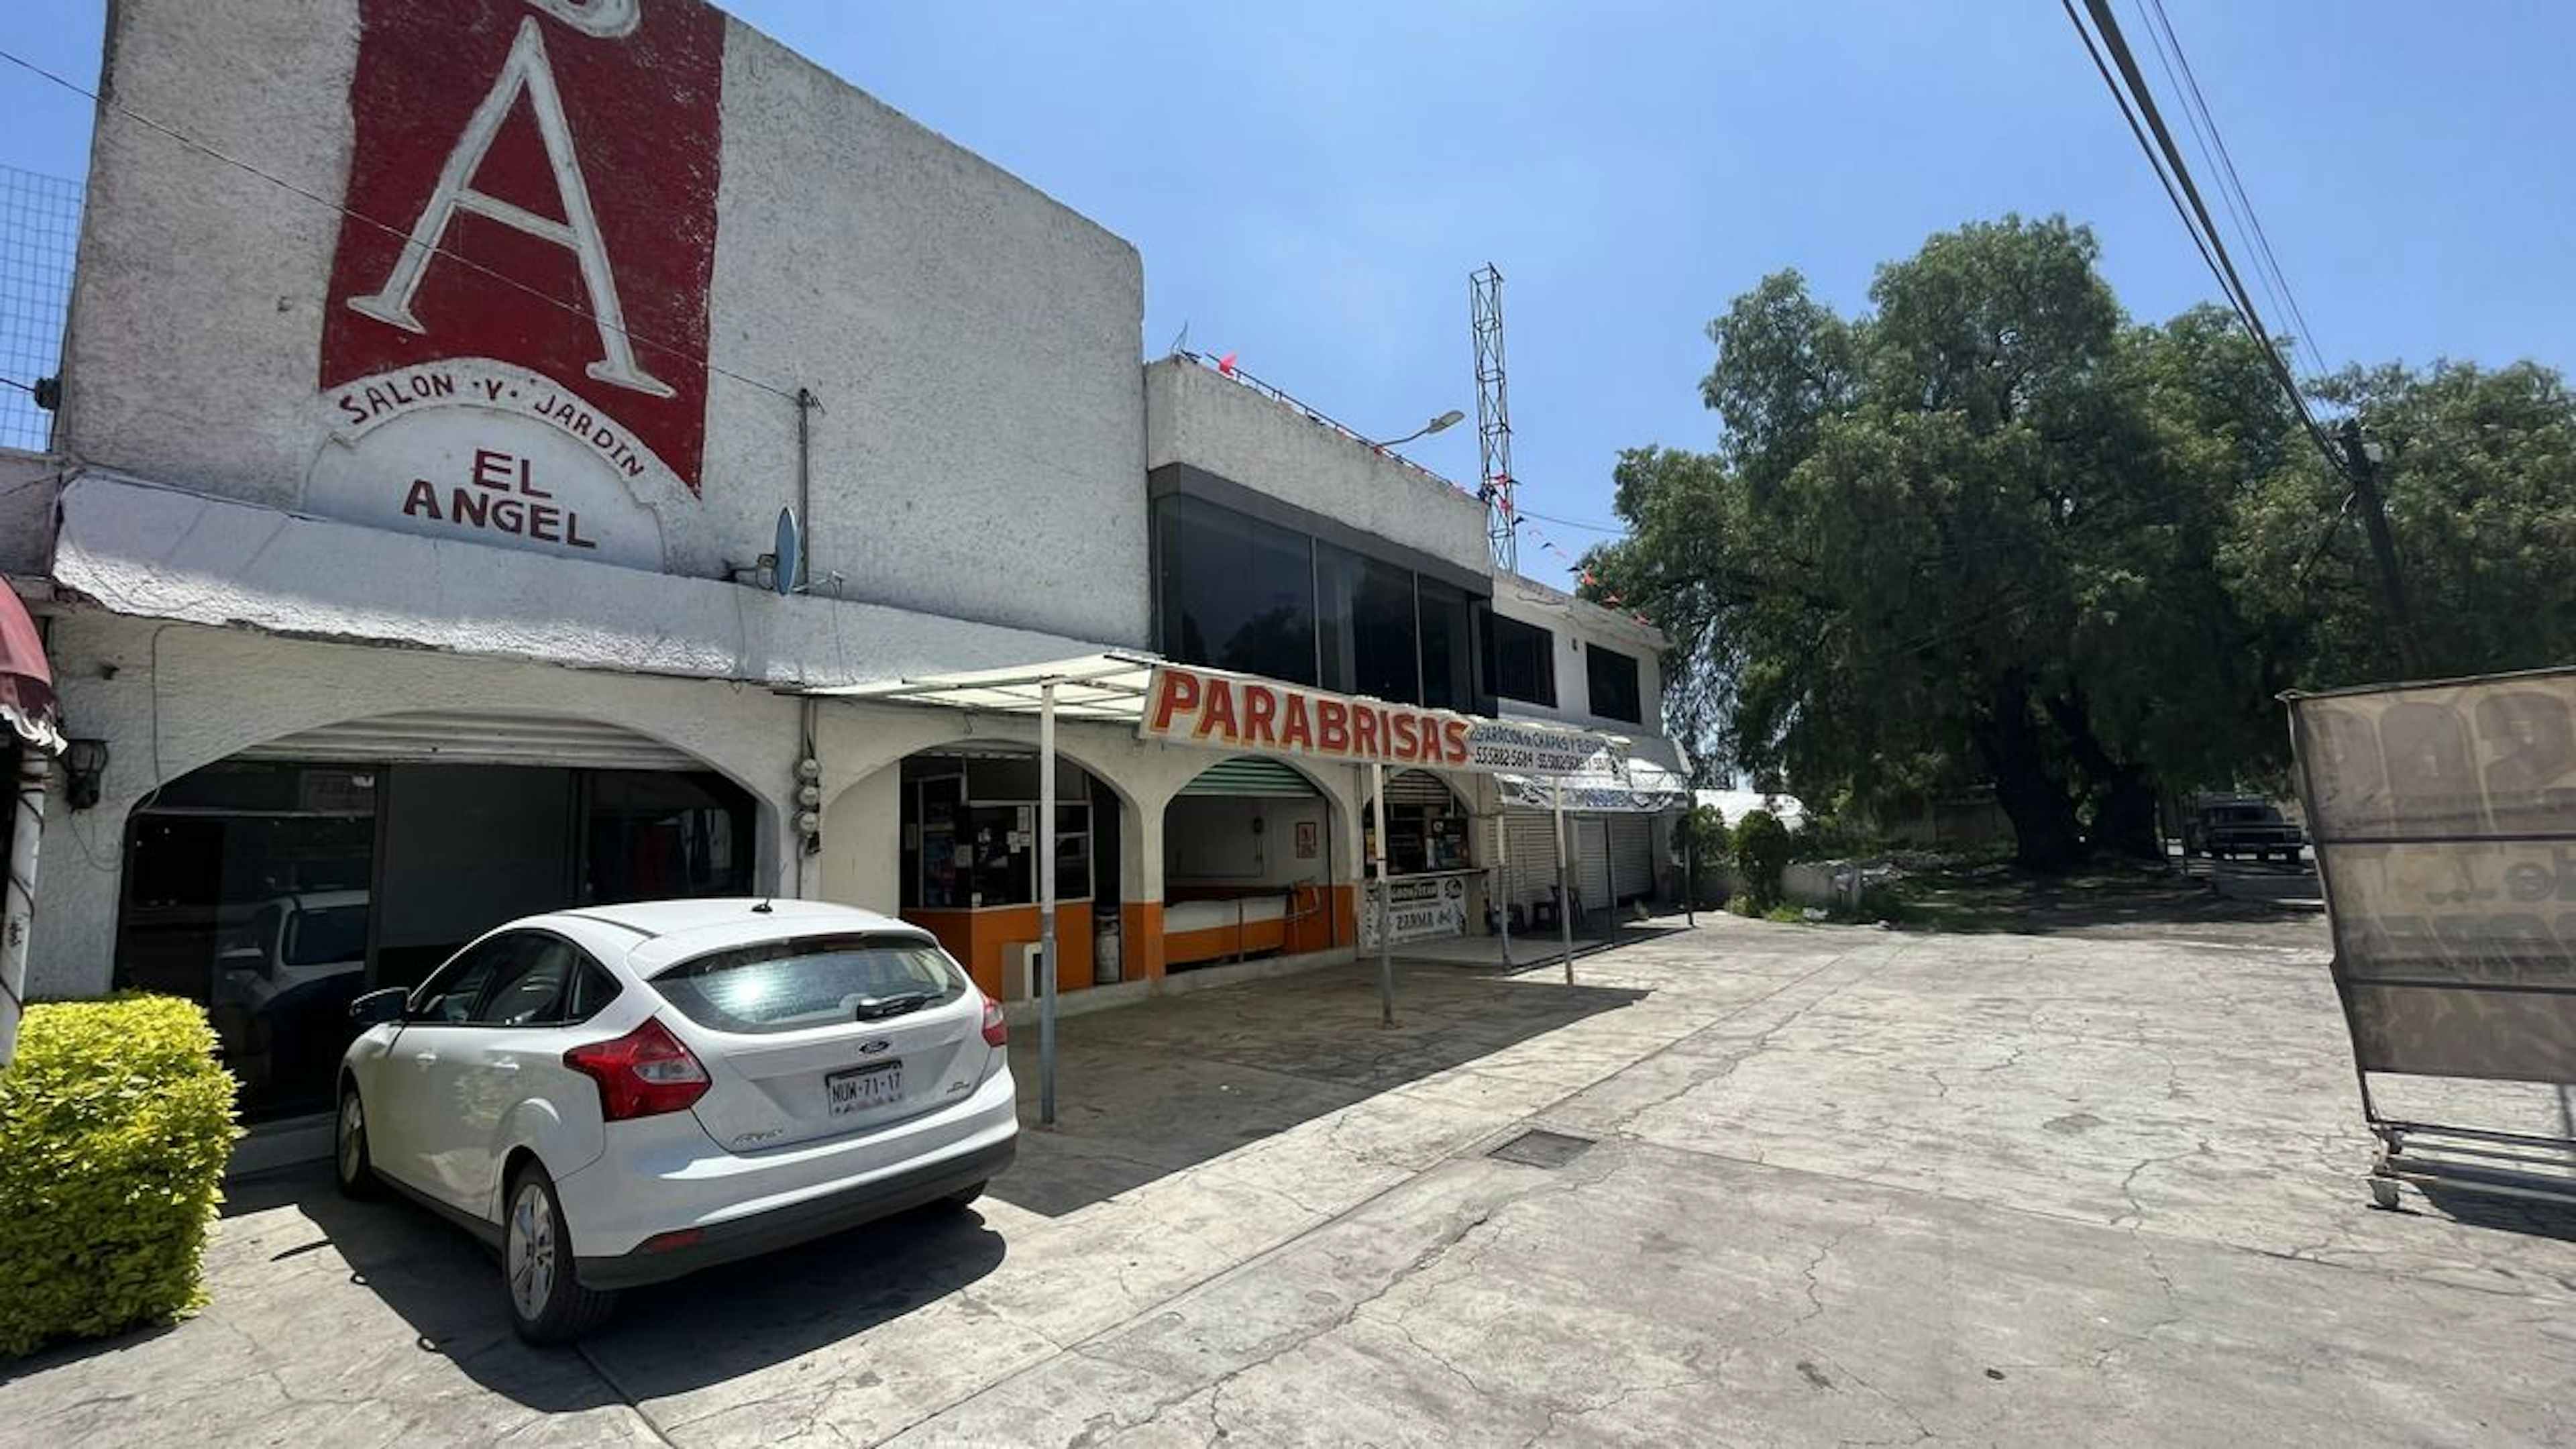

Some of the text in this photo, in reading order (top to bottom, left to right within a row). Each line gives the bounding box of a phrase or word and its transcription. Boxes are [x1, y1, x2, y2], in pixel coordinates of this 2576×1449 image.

[345, 14, 676, 398] A
[339, 373, 455, 425] SALON
[534, 394, 645, 478] JARDIN
[472, 448, 552, 498] EL
[403, 478, 596, 548] ANGEL
[1149, 670, 1470, 766] PARABRISAS
